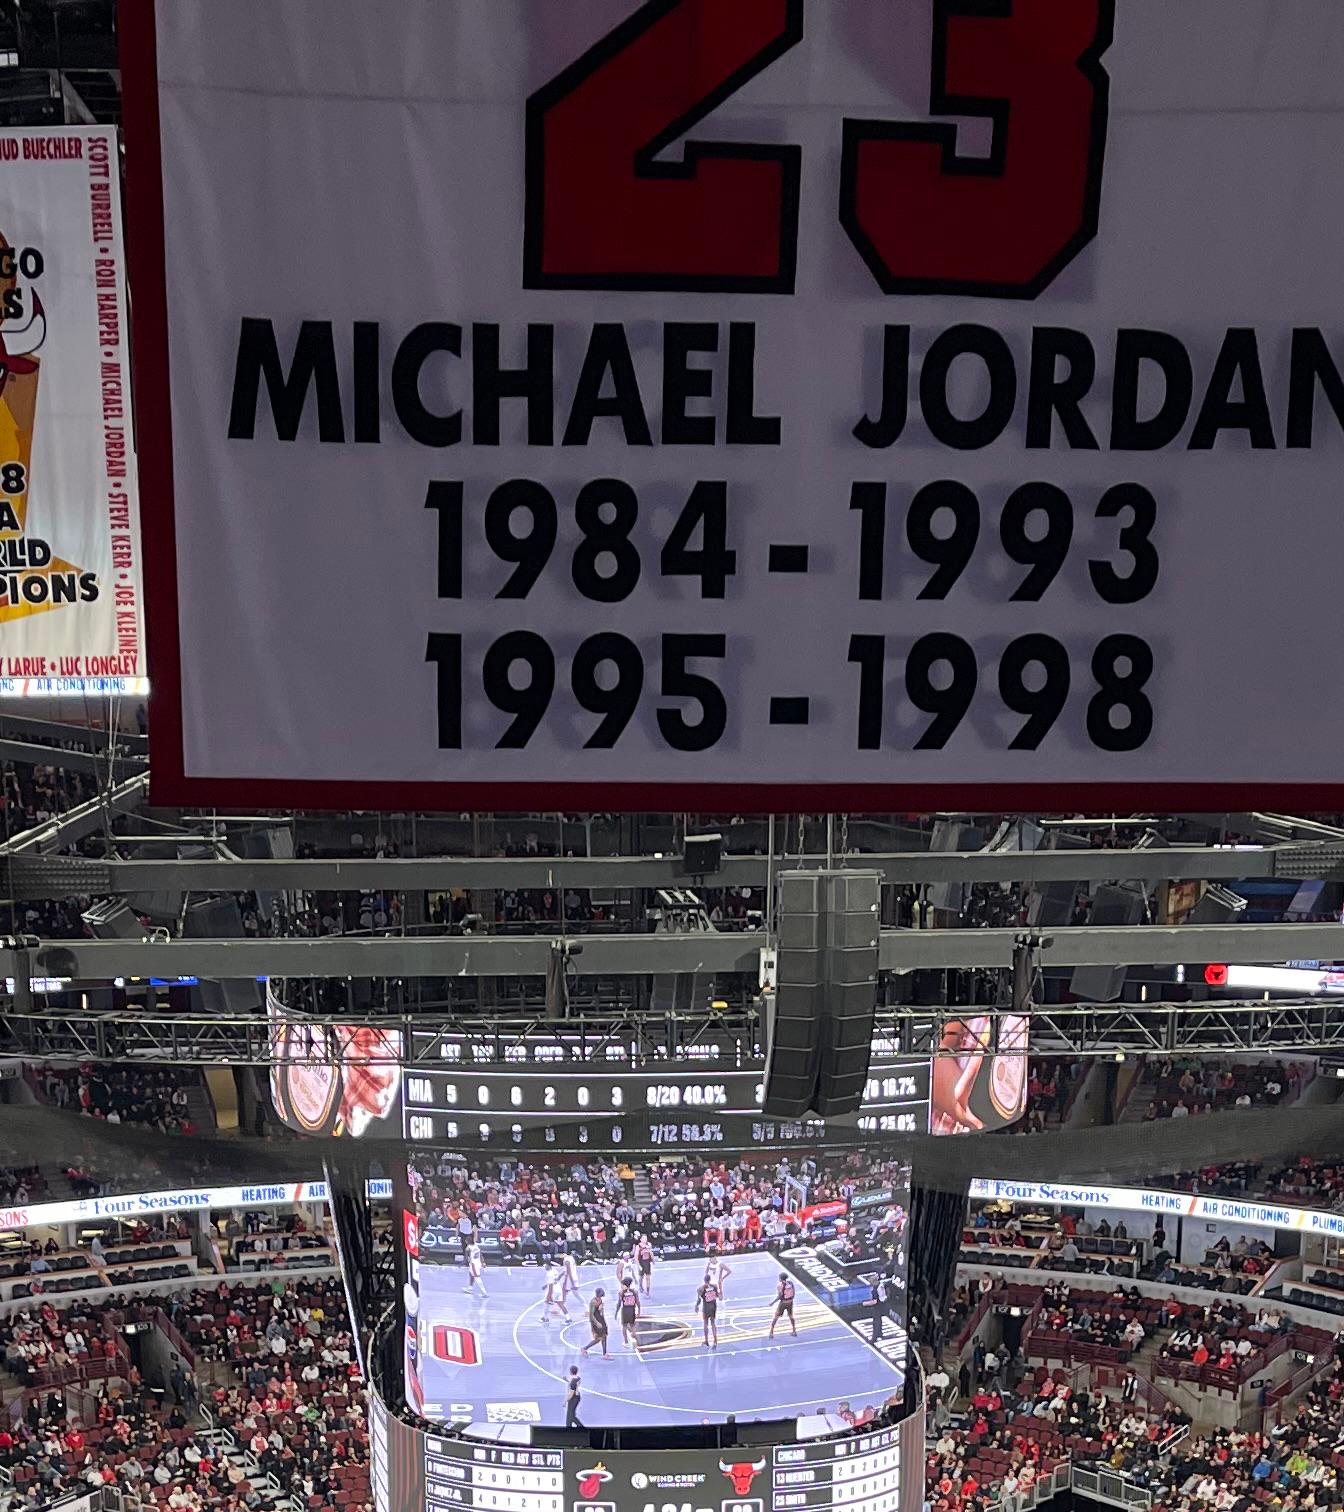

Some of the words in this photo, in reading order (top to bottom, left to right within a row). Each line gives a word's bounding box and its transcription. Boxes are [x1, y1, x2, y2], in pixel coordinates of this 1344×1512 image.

[22, 137, 83, 160] BUECHLER
[88, 137, 109, 177] SCOTT
[523, 0, 1116, 300] 23
[89, 183, 114, 243] BURRELL
[95, 259, 115, 288] RON
[97, 293, 120, 347] HARPER
[100, 362, 123, 421] MICHAEL
[226, 317, 781, 449] MICHAEL
[105, 425, 126, 479] JORDAN
[107, 492, 130, 530] STEVE
[111, 535, 133, 570] KERR
[114, 584, 135, 609] JOE
[116, 611, 138, 655] KLEINE
[6, 657, 47, 678] LARUE
[59, 656, 81, 676] LUC
[84, 655, 138, 676] LONGLEY
[409, 1079, 433, 1103] MIA
[994, 1181, 1037, 1199] Four
[1039, 1184, 1110, 1203] Seasons
[1142, 1195, 1181, 1210] HEATING
[1203, 1202, 1218, 1216] AIR
[1222, 1203, 1290, 1224] CONDITIONING
